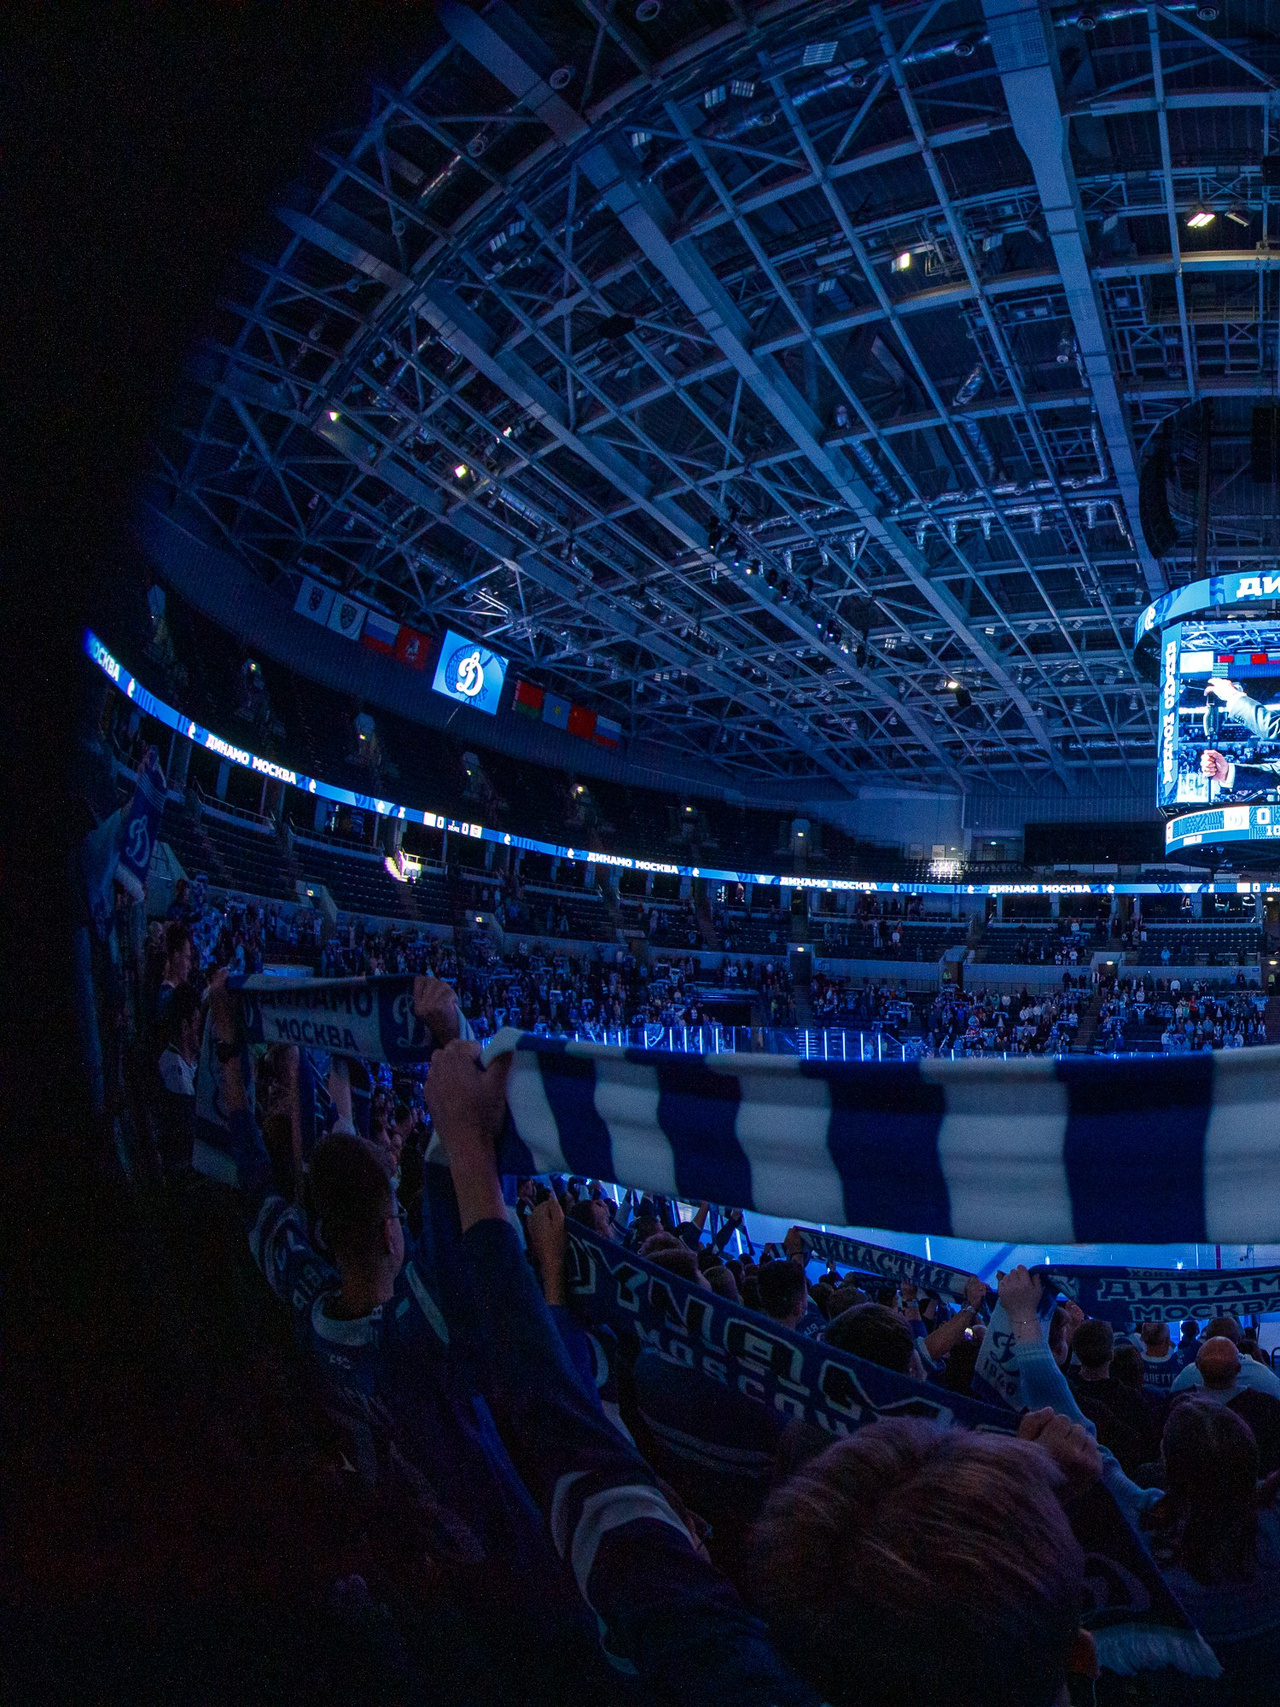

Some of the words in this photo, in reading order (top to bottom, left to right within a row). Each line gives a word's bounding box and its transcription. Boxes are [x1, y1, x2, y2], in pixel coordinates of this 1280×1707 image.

[93, 641, 120, 682] ОСКВА
[1163, 640, 1176, 709] ДИНАМО
[206, 733, 249, 766] ДИНАМО
[252, 756, 297, 785] МОСКВА
[1163, 711, 1175, 785] МОСКВА
[1256, 807, 1271, 825] 0
[586, 851, 633, 868] ДИНАМО
[635, 858, 679, 875] МОСКВА
[779, 876, 828, 889] ДИНАМО
[830, 879, 878, 891] МОСКВА
[987, 883, 1039, 895] ДИНАМО
[1041, 883, 1092, 895] МОСКВА
[275, 1017, 361, 1052] МОСКВА
[808, 1232, 954, 1290] ДИНАСТИЯ
